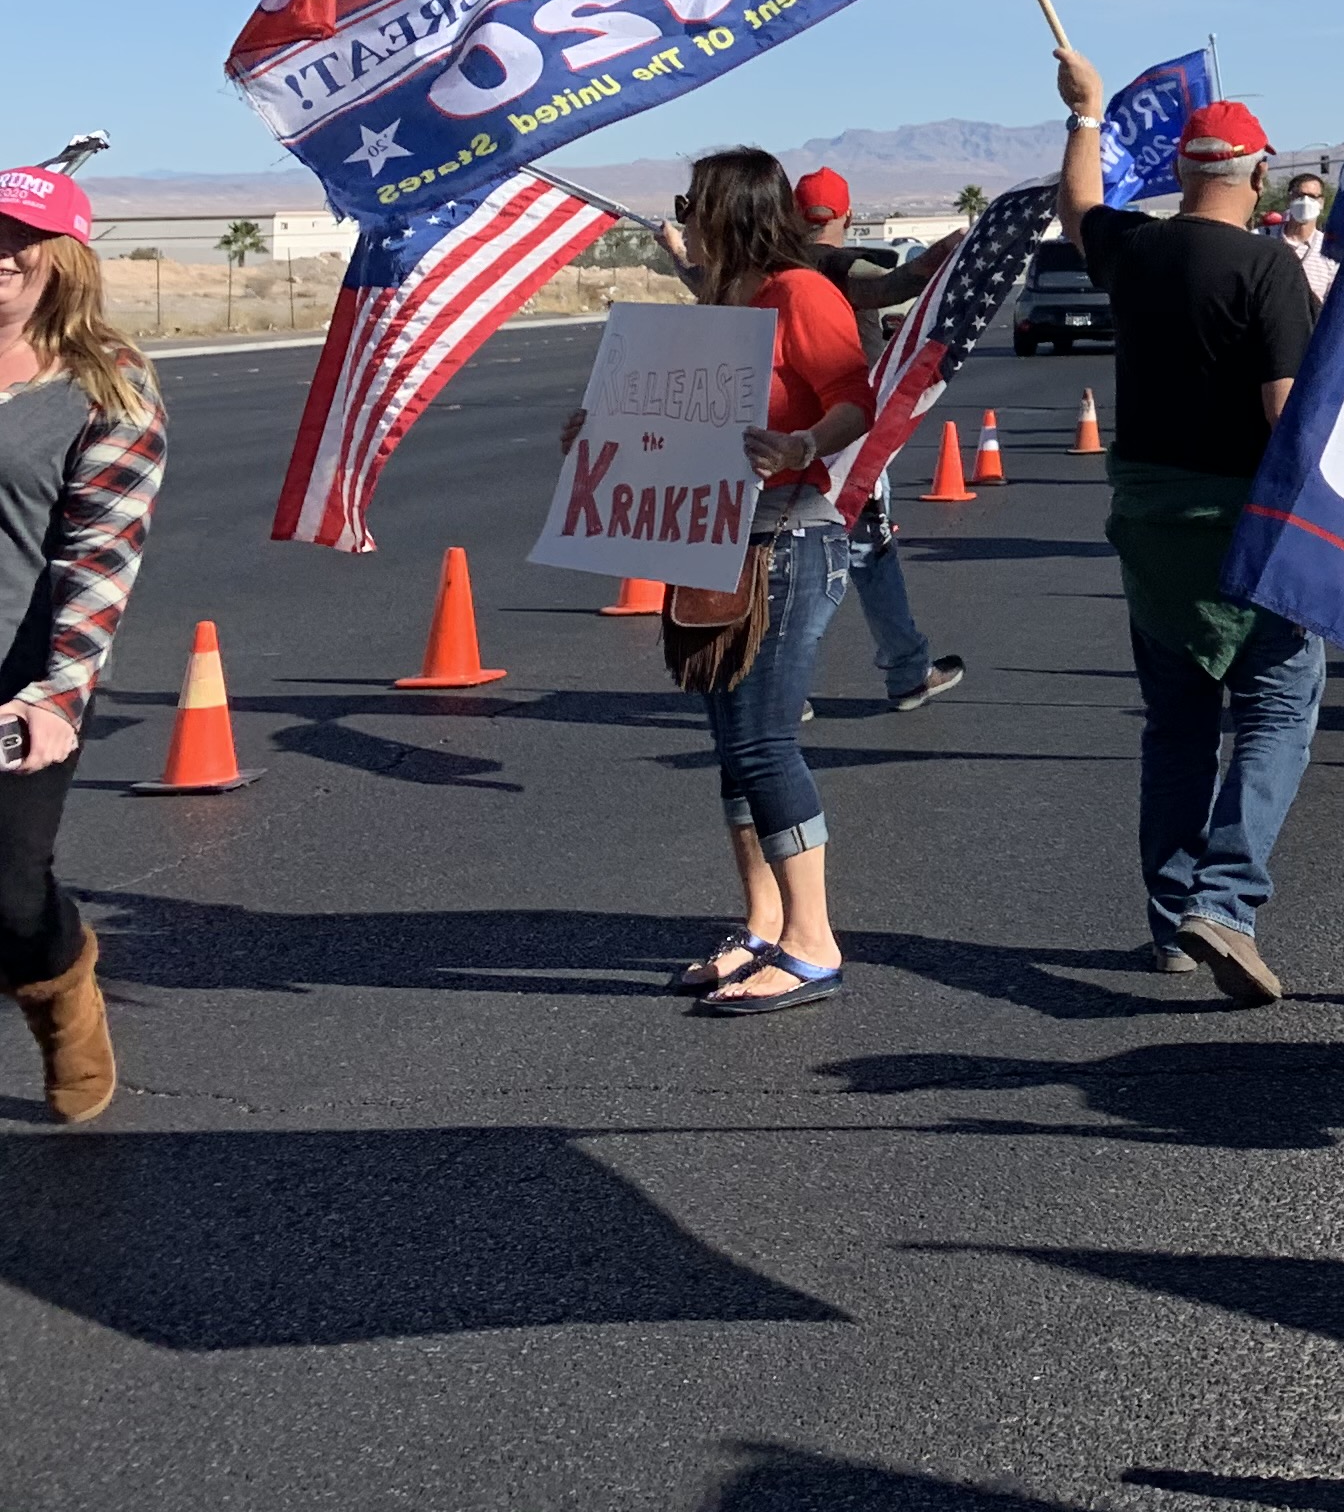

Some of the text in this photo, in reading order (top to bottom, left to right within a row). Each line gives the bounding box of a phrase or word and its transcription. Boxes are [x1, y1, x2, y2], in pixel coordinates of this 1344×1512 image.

[0, 173, 55, 199] RUMP
[590, 333, 755, 427] RELEASE
[642, 432, 665, 452] the
[560, 439, 746, 545] KRAKEN
